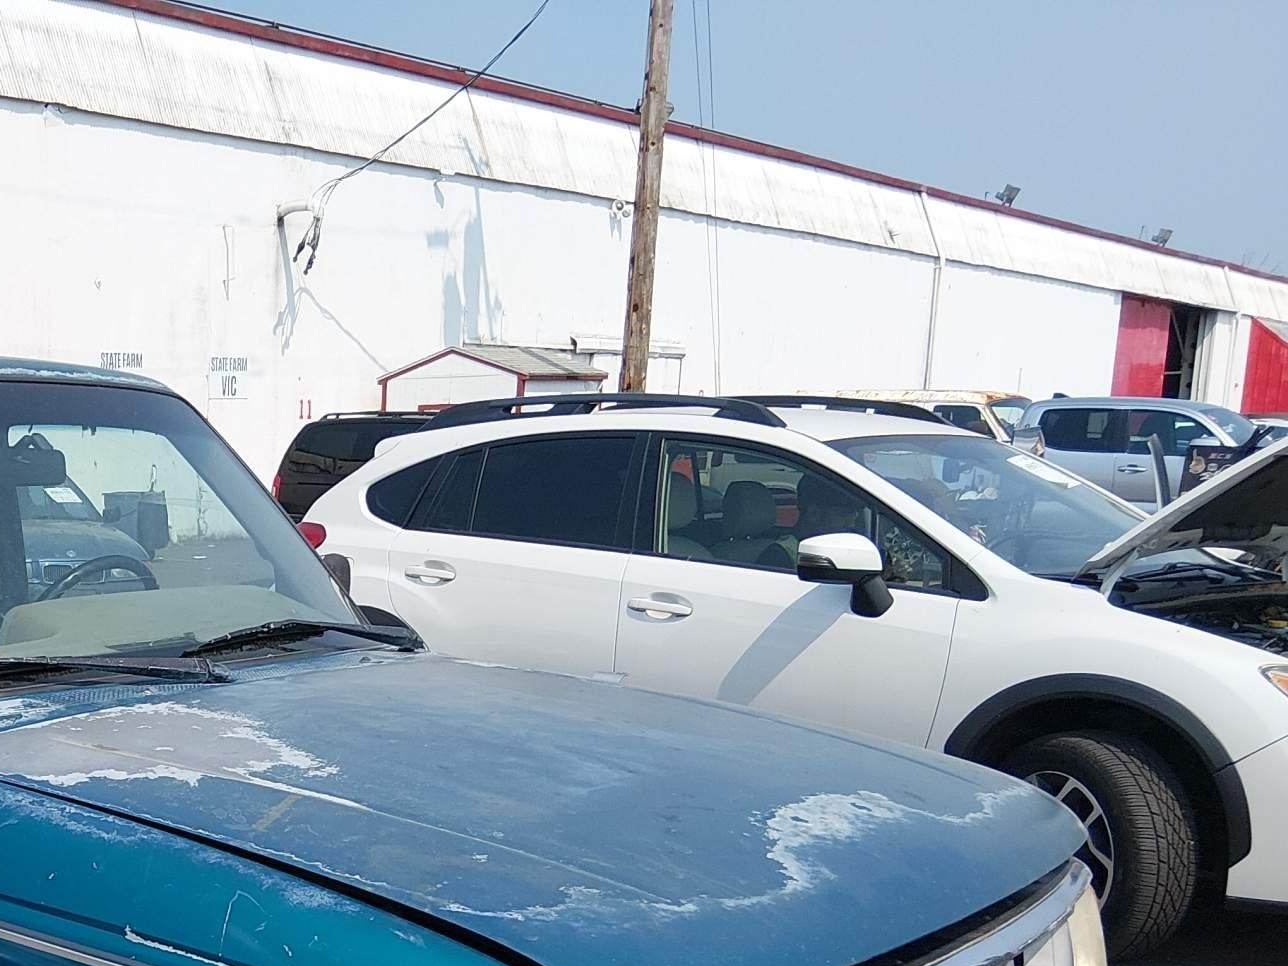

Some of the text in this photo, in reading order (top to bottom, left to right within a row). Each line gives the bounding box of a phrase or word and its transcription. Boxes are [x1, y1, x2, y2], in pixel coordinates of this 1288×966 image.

[100, 352, 143, 369] STATE FARM
[210, 357, 248, 372] STATE FARM
[221, 375, 237, 397] VIC
